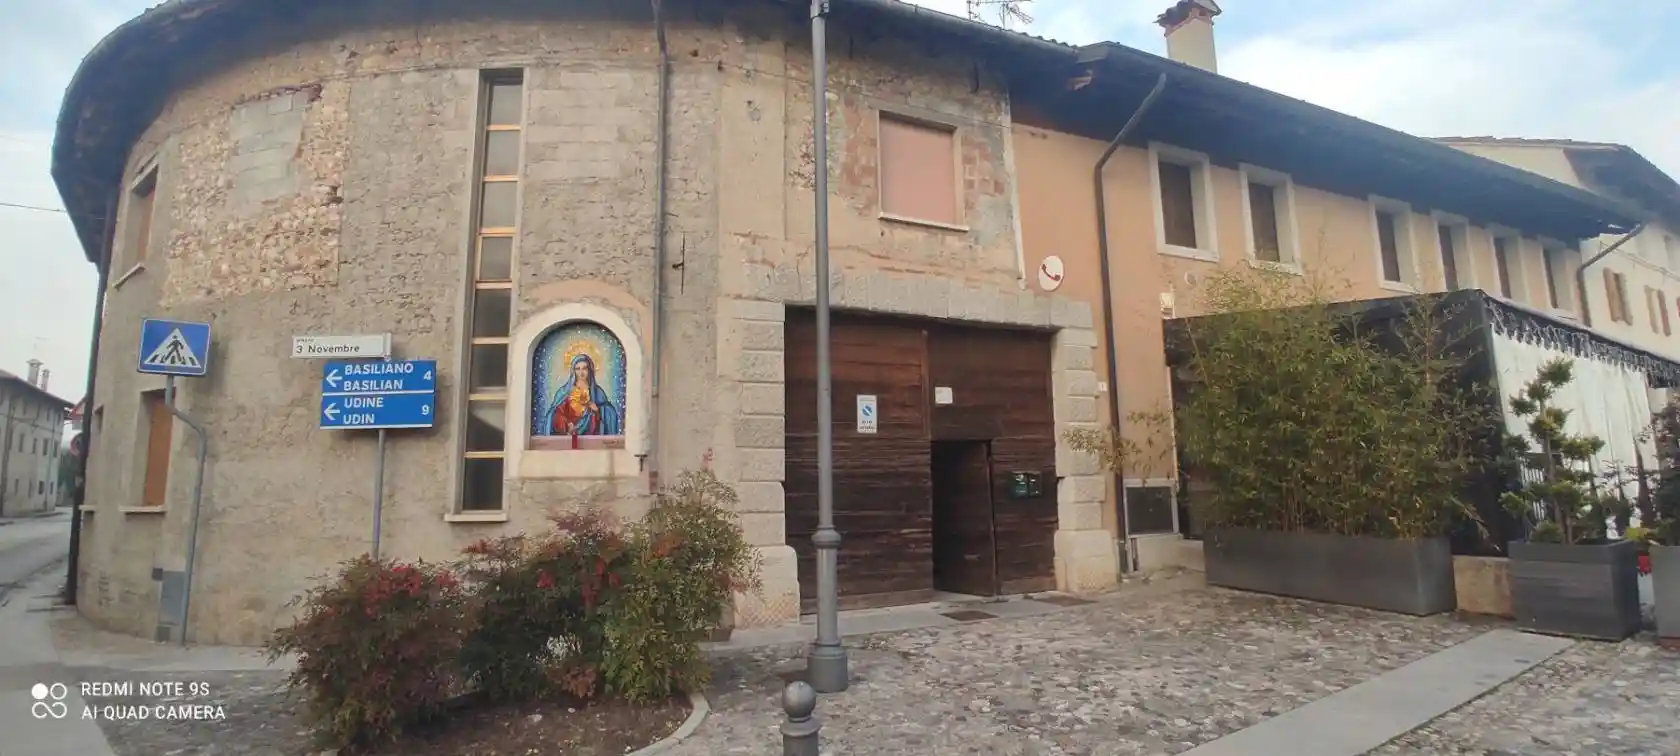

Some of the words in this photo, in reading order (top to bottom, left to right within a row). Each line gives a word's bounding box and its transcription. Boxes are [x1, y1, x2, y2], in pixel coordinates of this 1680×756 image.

[296, 345, 303, 354] 3
[308, 344, 360, 354] Novembre
[344, 362, 414, 375] BASILIANO
[423, 370, 432, 380] 4
[343, 379, 403, 391] BASILIAN
[344, 397, 385, 408] UDINE
[421, 404, 430, 415] 9
[343, 414, 375, 424] UDIN
